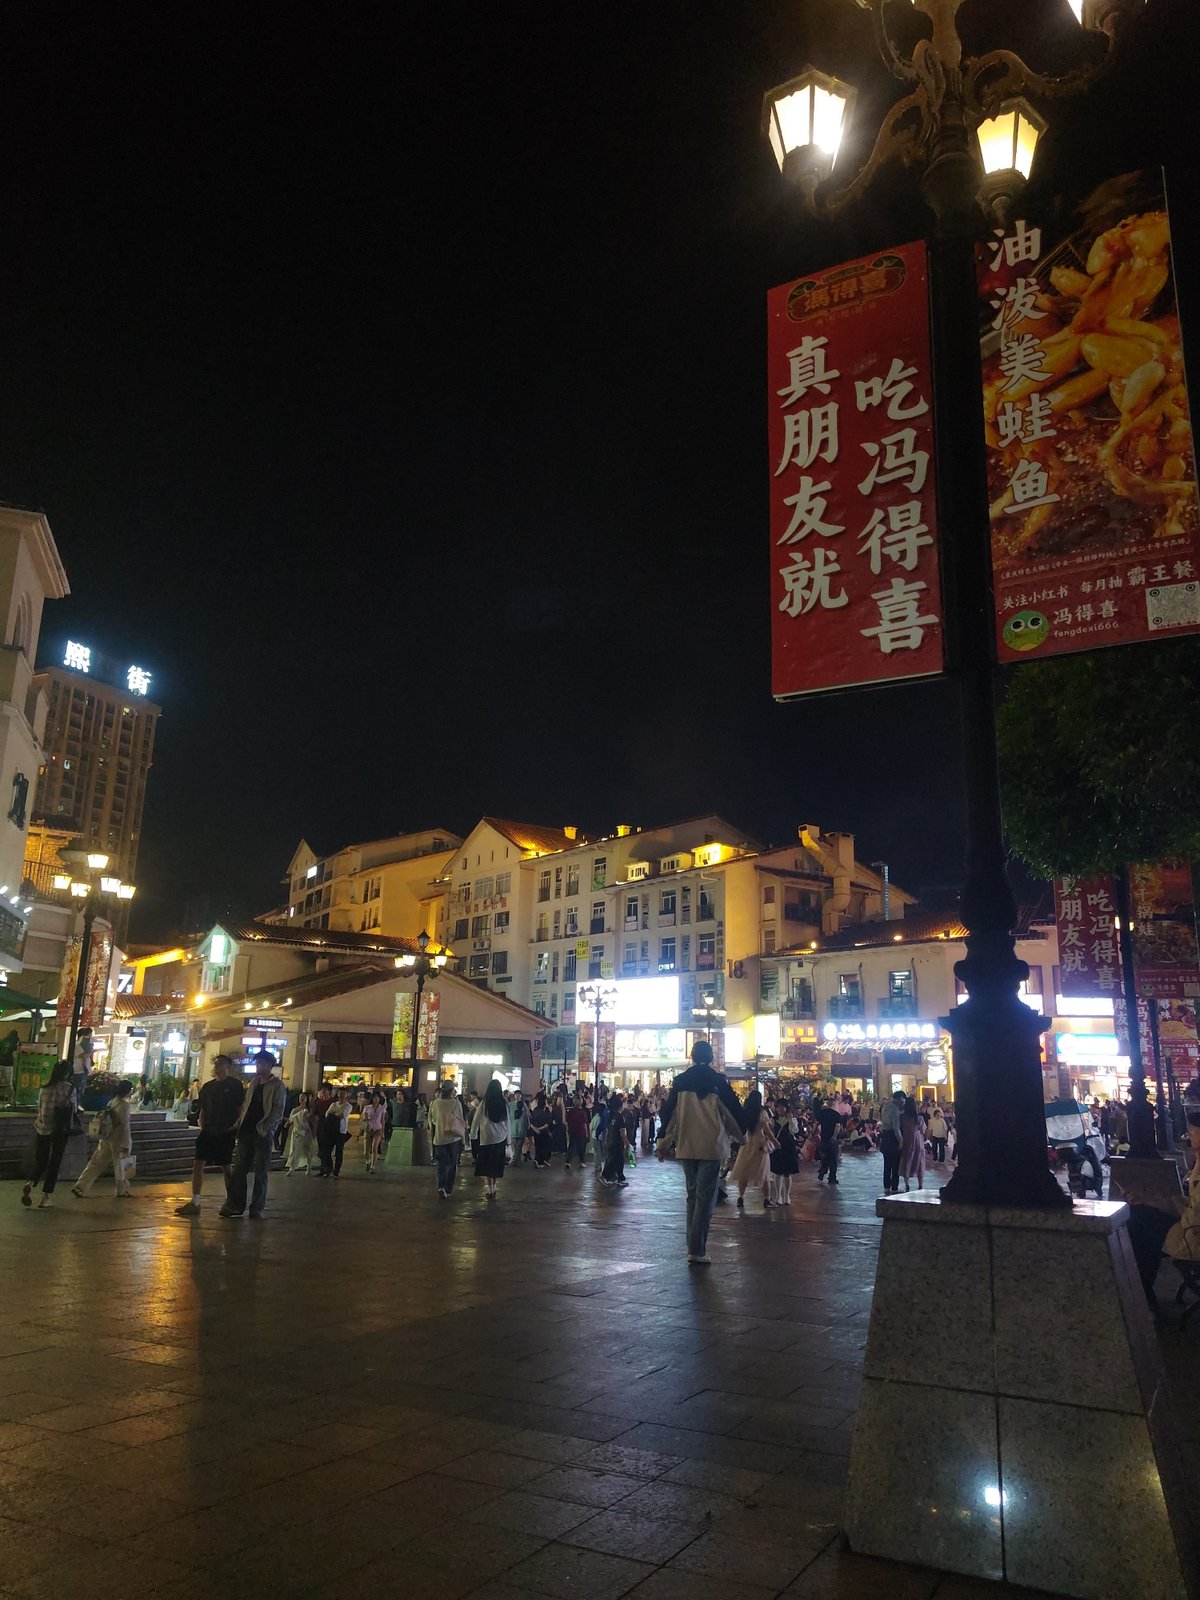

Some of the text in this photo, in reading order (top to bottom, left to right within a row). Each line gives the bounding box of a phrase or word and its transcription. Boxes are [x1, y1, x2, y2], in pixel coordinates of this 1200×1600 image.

[985, 220, 1060, 516] 油泼美蛙鱼
[775, 336, 849, 617] 真朋友就
[853, 358, 940, 655] 吃冯得喜
[1003, 585, 1069, 610] 关注小红书
[1053, 599, 1119, 626] 冯得喜
[1053, 620, 1119, 639] fengdexi666
[727, 957, 744, 979] 18
[1059, 873, 1087, 972] 真朋友就
[1086, 888, 1120, 990] 吃冯得喜
